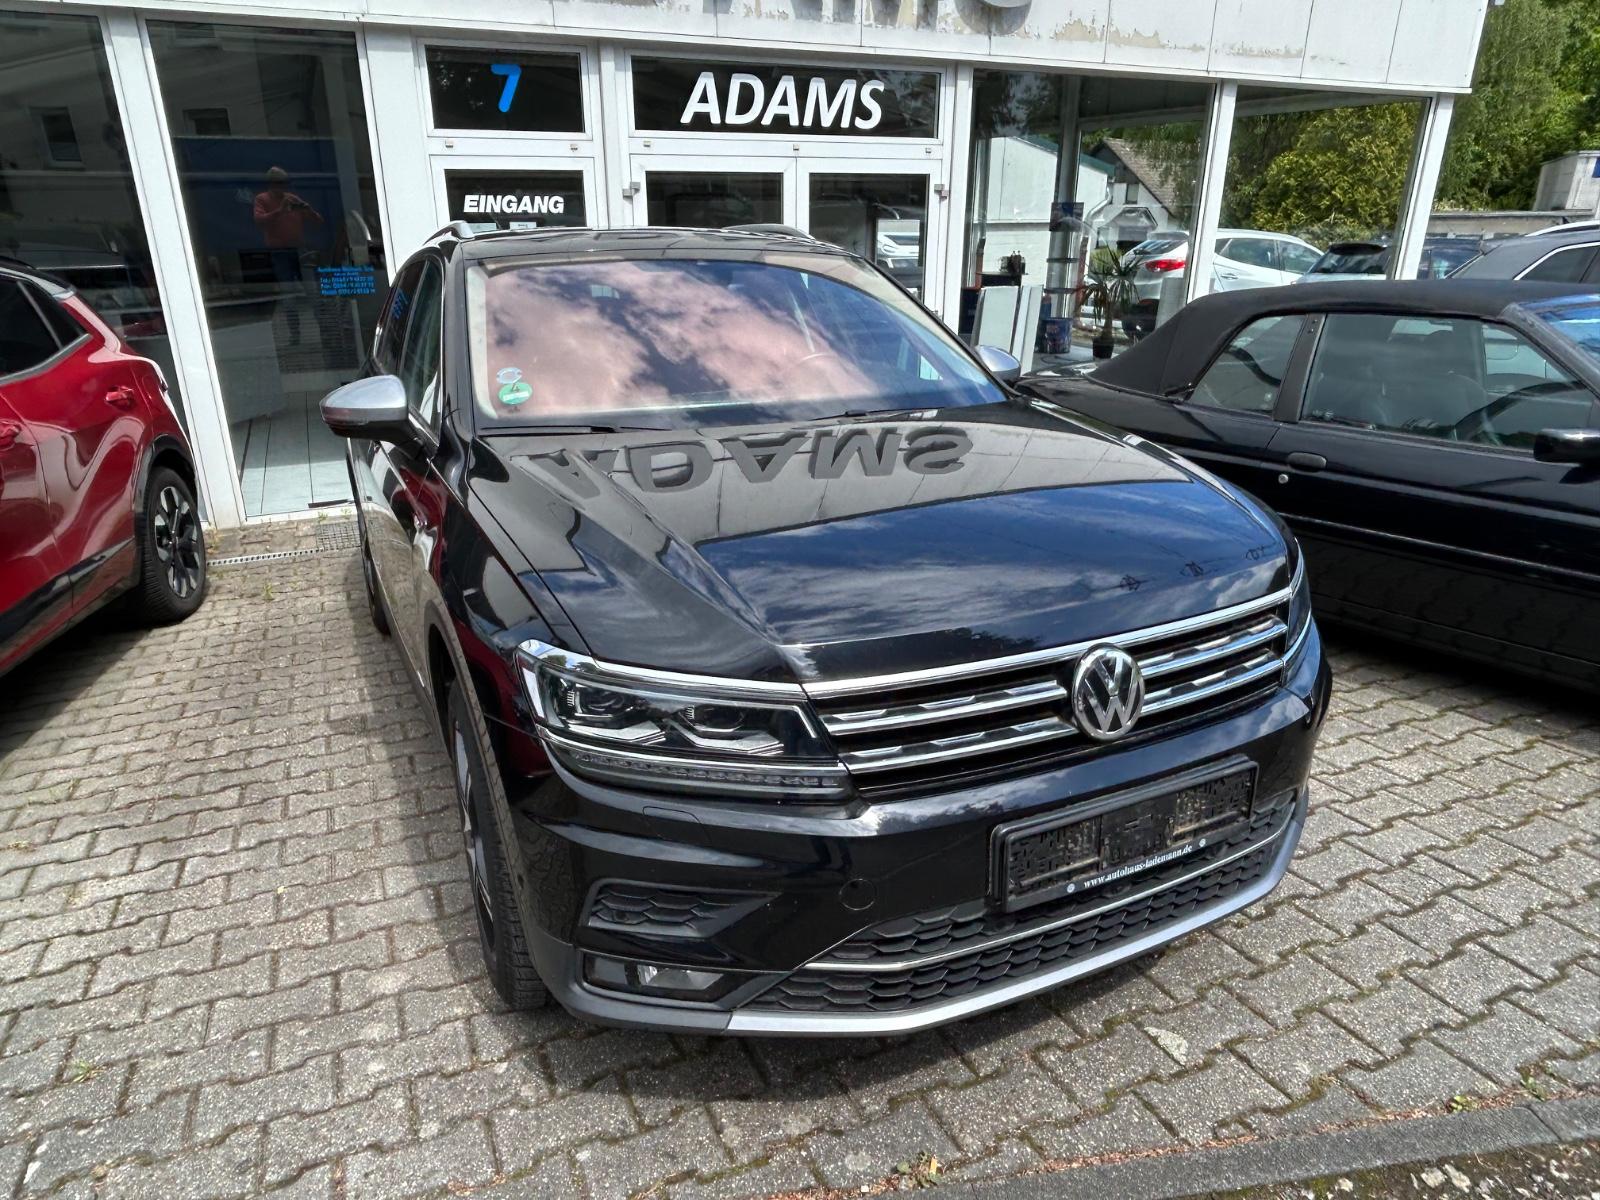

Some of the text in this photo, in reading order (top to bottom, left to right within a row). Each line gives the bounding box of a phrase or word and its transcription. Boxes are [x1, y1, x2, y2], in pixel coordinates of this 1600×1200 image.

[491, 64, 522, 113] 7
[680, 71, 885, 130] ADAMS
[463, 194, 565, 214] EINGANG
[1079, 650, 1141, 738] VW
